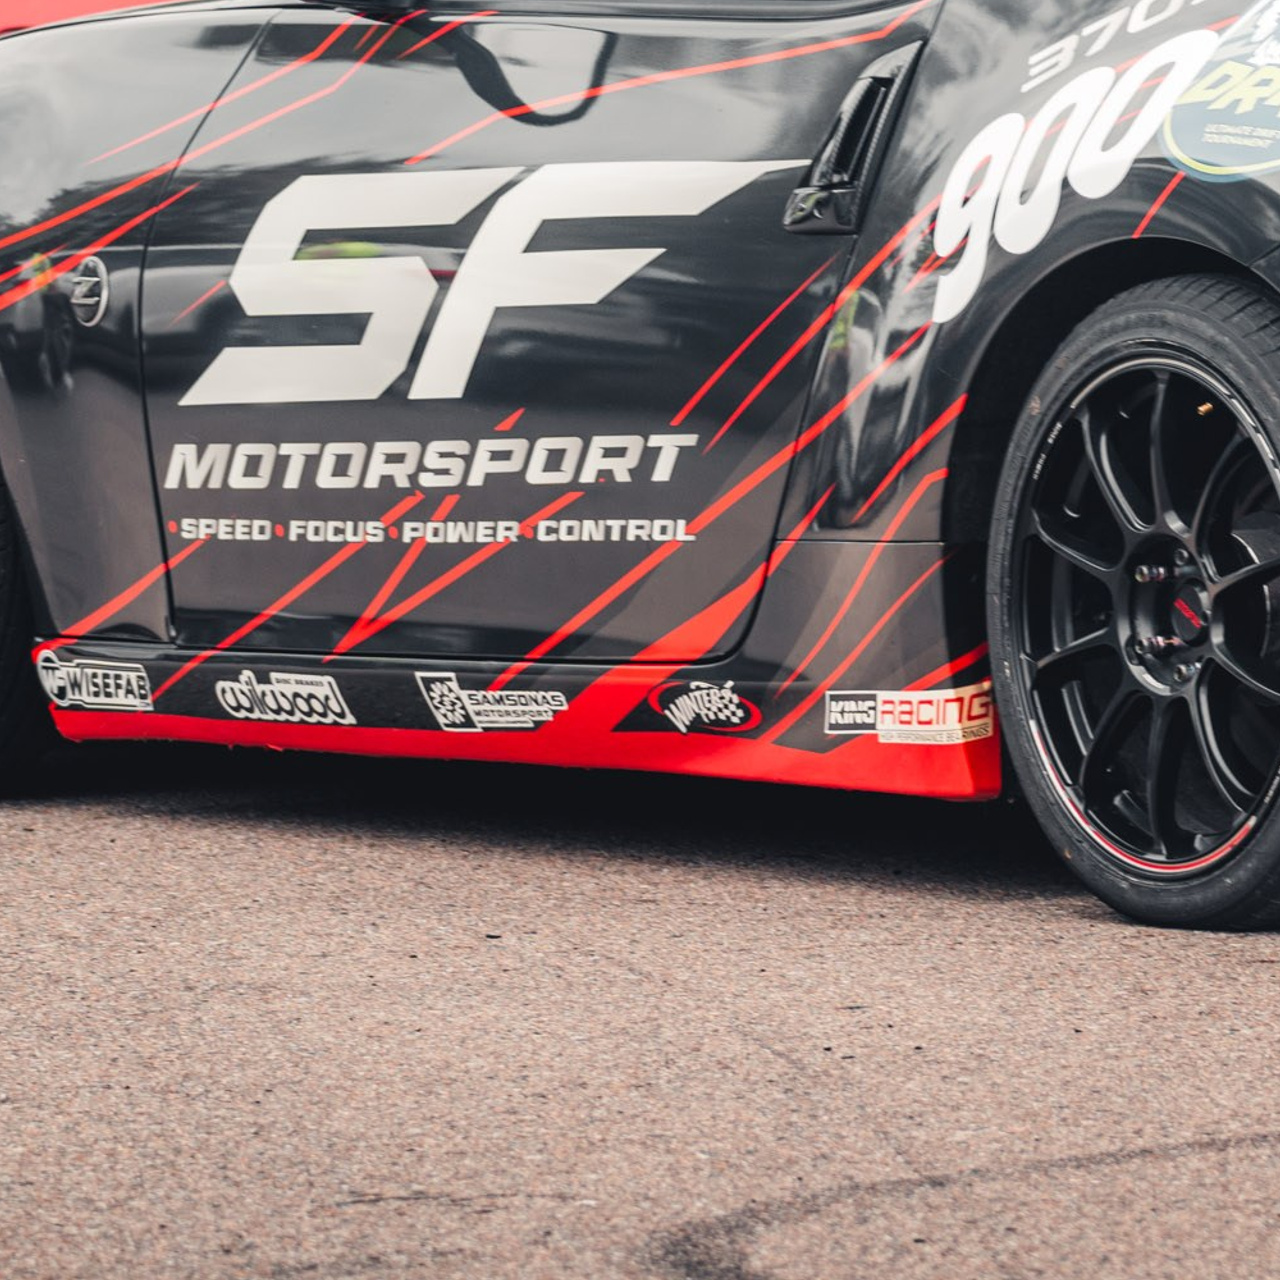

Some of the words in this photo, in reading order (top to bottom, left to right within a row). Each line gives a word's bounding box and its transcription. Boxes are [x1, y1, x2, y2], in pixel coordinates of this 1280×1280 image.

[932, 28, 1220, 324] 900
[178, 159, 808, 406] SF
[164, 433, 699, 490] MOTORSPORT
[180, 517, 272, 541] SPEED
[287, 520, 386, 544] FOCUS
[401, 520, 521, 544] POWER
[535, 518, 698, 543] CONTROL
[66, 669, 149, 701] WISEFAB
[220, 674, 347, 720] wilwood
[467, 693, 565, 708] SAMSONAS
[473, 708, 550, 719] MOTORSPORT
[830, 700, 876, 724] KING
